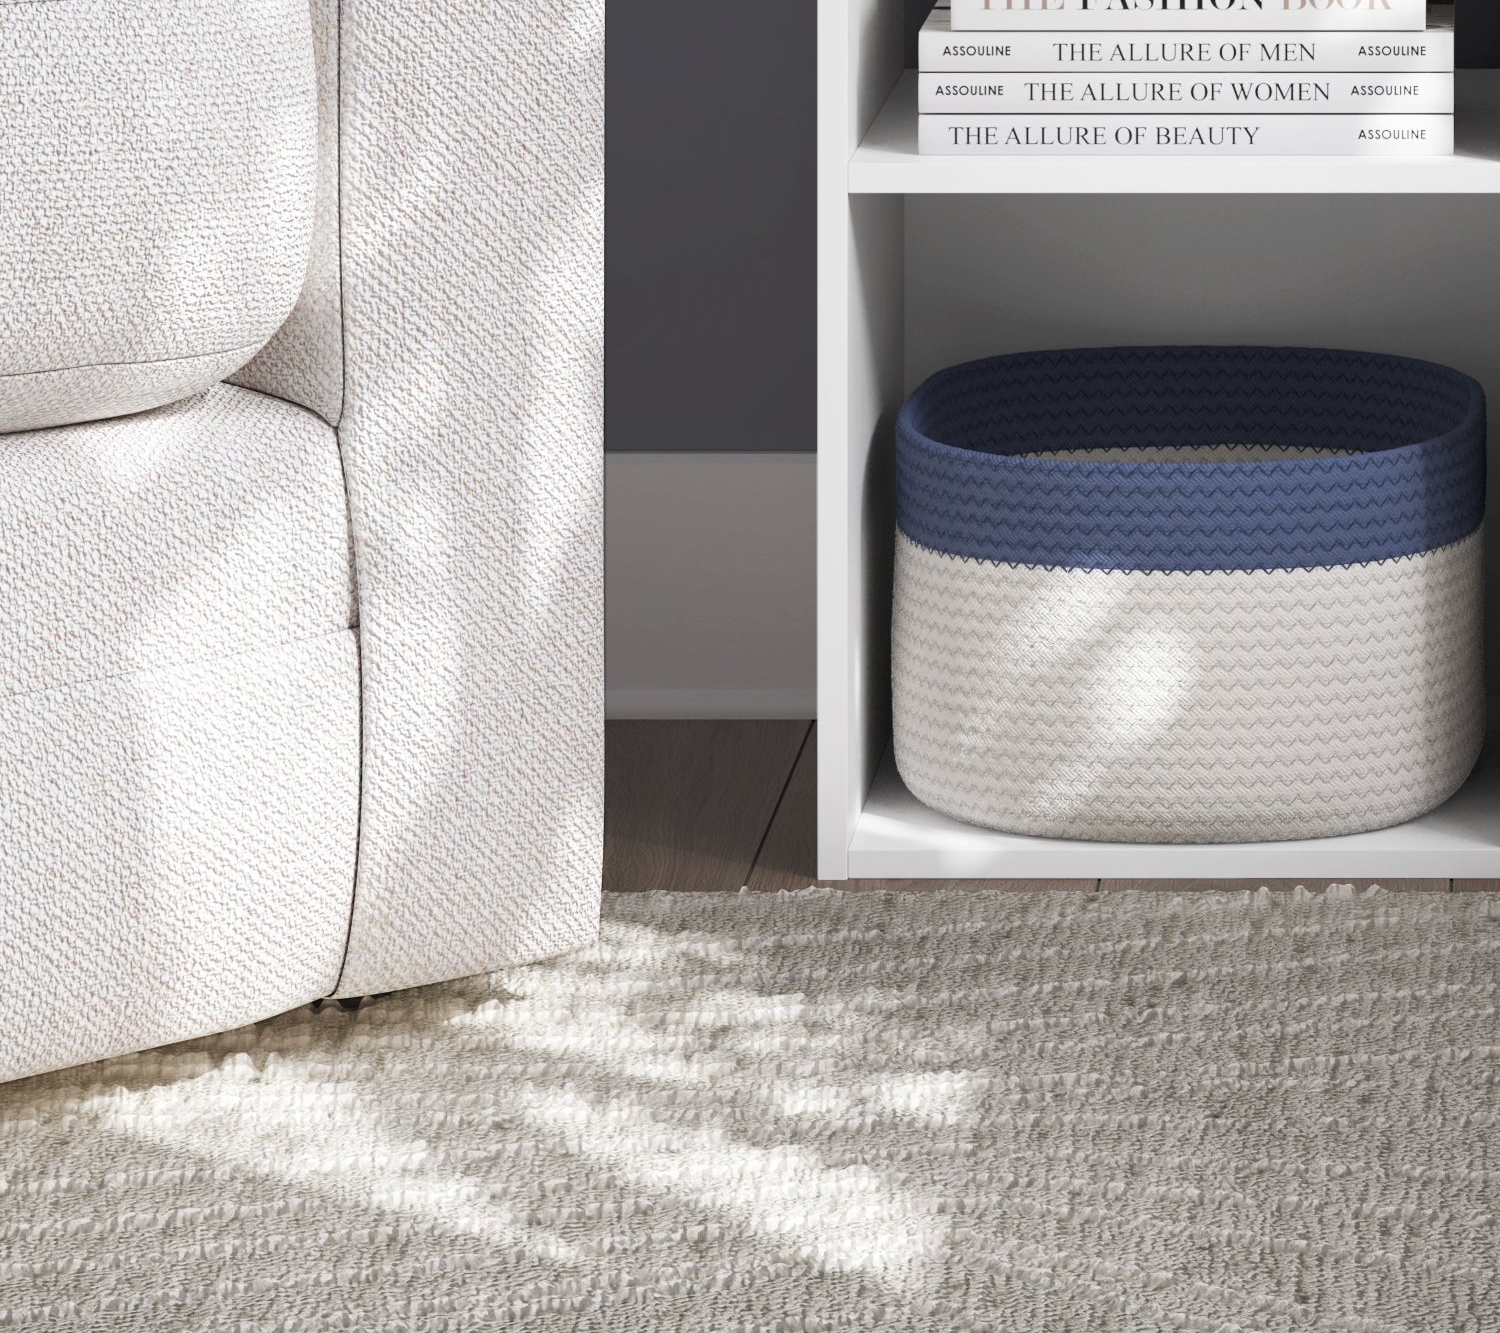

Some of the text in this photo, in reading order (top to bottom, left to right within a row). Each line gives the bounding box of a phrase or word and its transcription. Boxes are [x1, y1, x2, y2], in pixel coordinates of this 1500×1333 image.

[943, 46, 1011, 56] ASSOULINE
[1053, 43, 1316, 61] THE ALLURE OF MEN
[1358, 46, 1426, 56] ASSOULINE
[935, 86, 1004, 96] ASSOULINE
[1024, 83, 1331, 101] THE ALLURE OF WOMEN
[1351, 86, 1419, 96] ASSOULINE
[949, 127, 1260, 145] THE ALLURE OF BEAUTY
[1358, 129, 1426, 140] ASSOULINE
